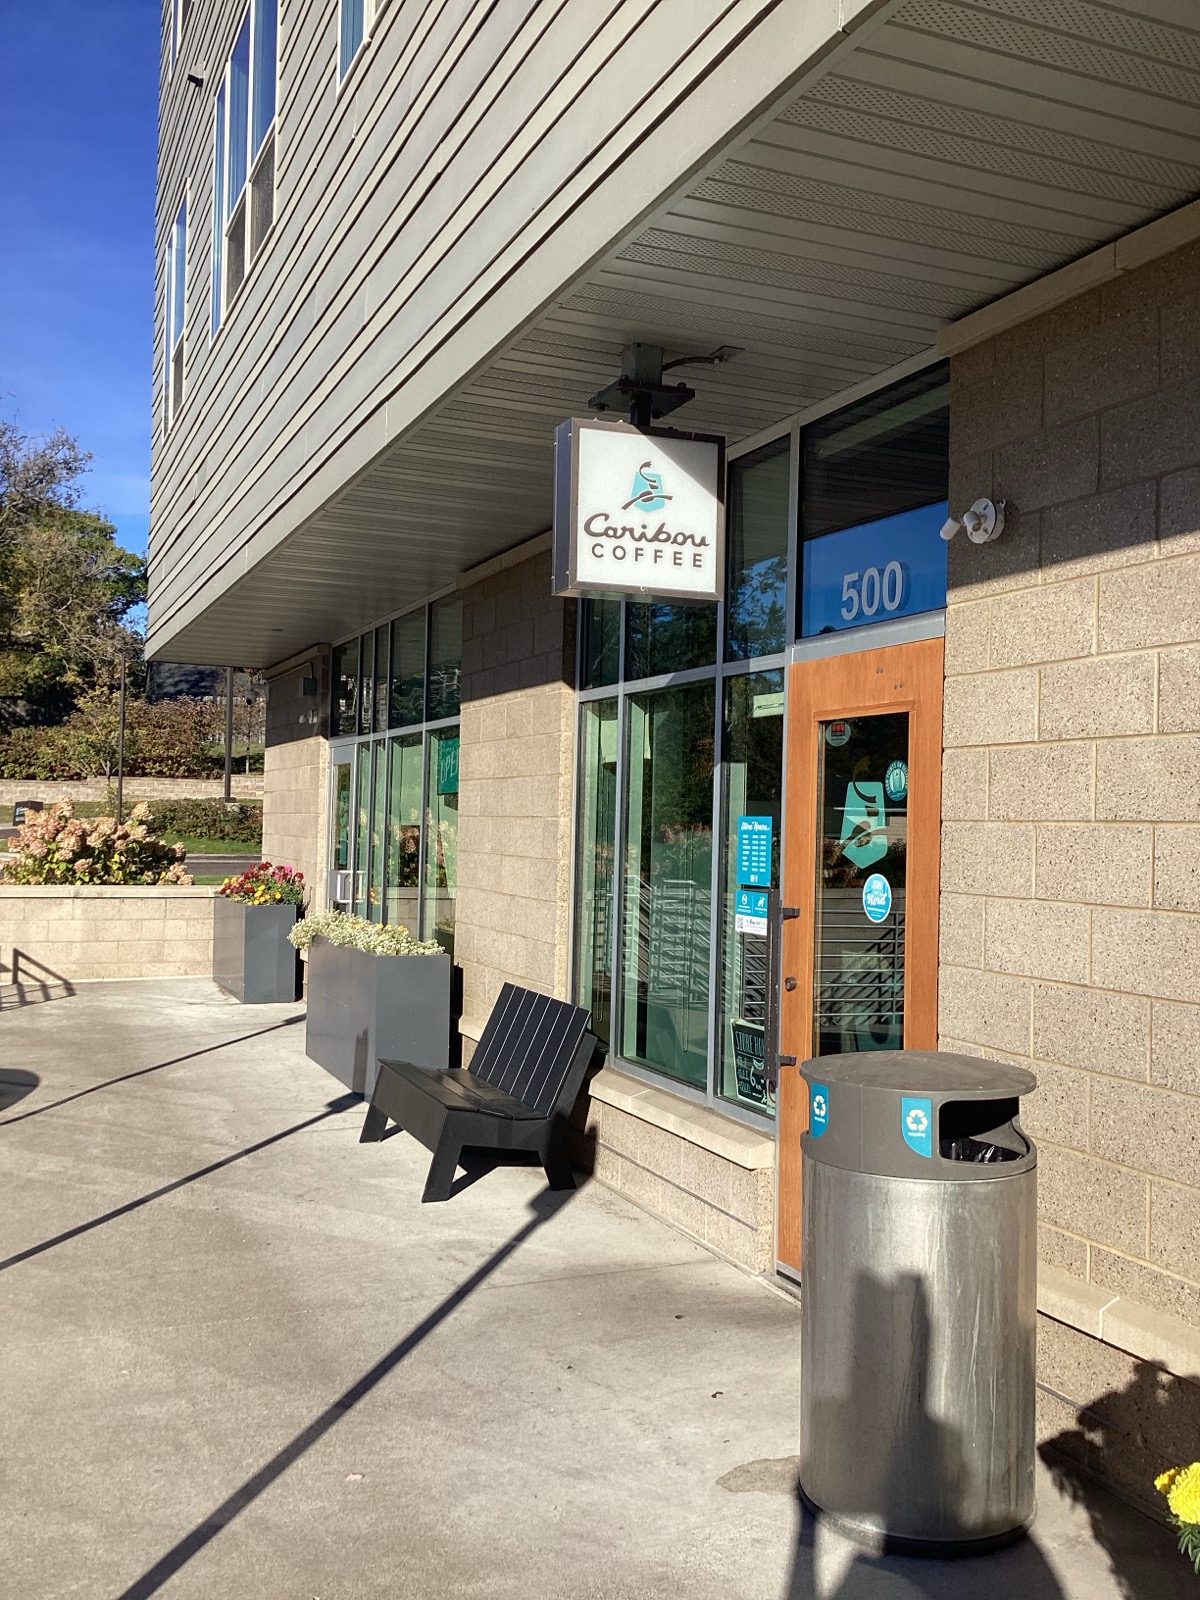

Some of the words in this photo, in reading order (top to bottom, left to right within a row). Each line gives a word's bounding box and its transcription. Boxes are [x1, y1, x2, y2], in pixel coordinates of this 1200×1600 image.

[584, 513, 710, 547] Caribou
[591, 543, 703, 568] COFFEE
[841, 561, 903, 620] 500
